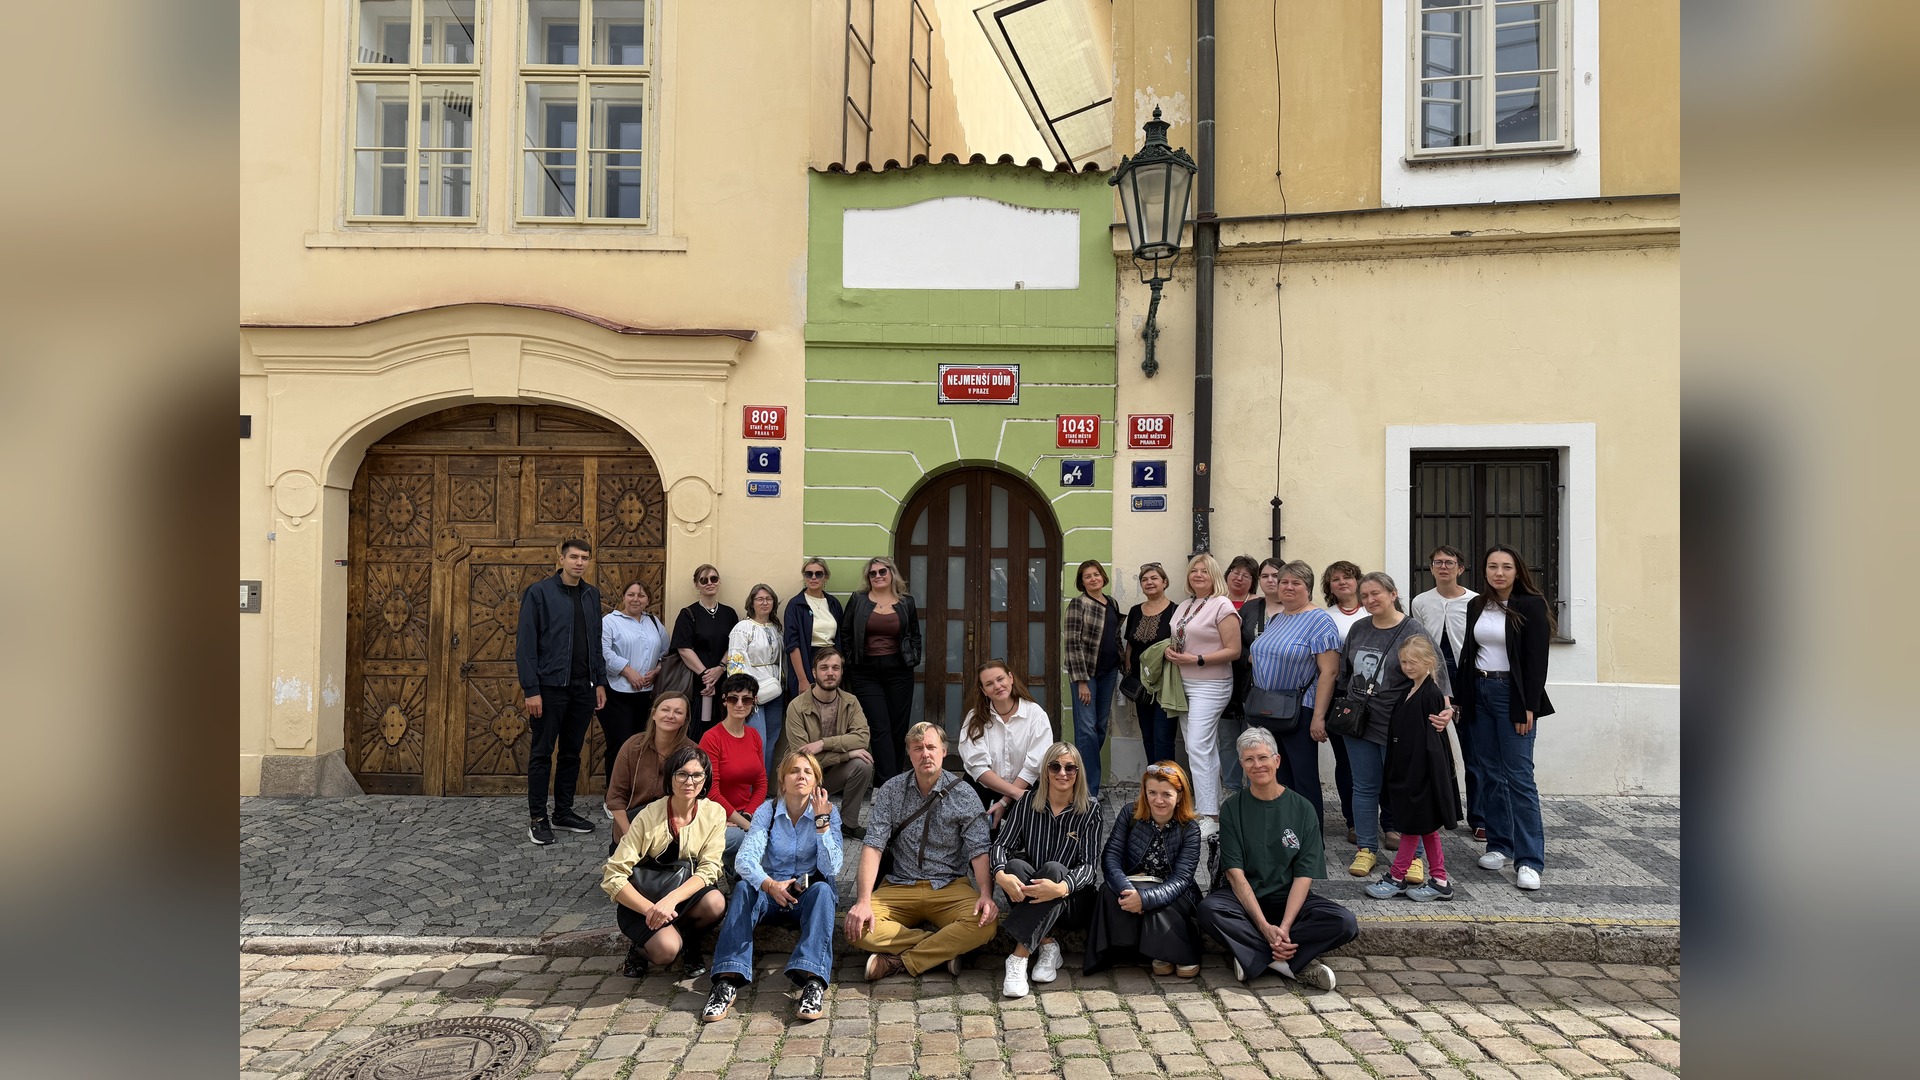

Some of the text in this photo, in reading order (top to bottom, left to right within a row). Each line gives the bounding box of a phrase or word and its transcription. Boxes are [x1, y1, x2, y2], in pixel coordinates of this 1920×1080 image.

[947, 371, 1011, 386] NEJMENŠÍ DŮM
[751, 410, 778, 424] 809
[1137, 417, 1164, 432] 808
[1062, 419, 1094, 433] 1043
[759, 452, 769, 467] 6
[1072, 465, 1082, 480] 4
[1144, 466, 1154, 481] 2
